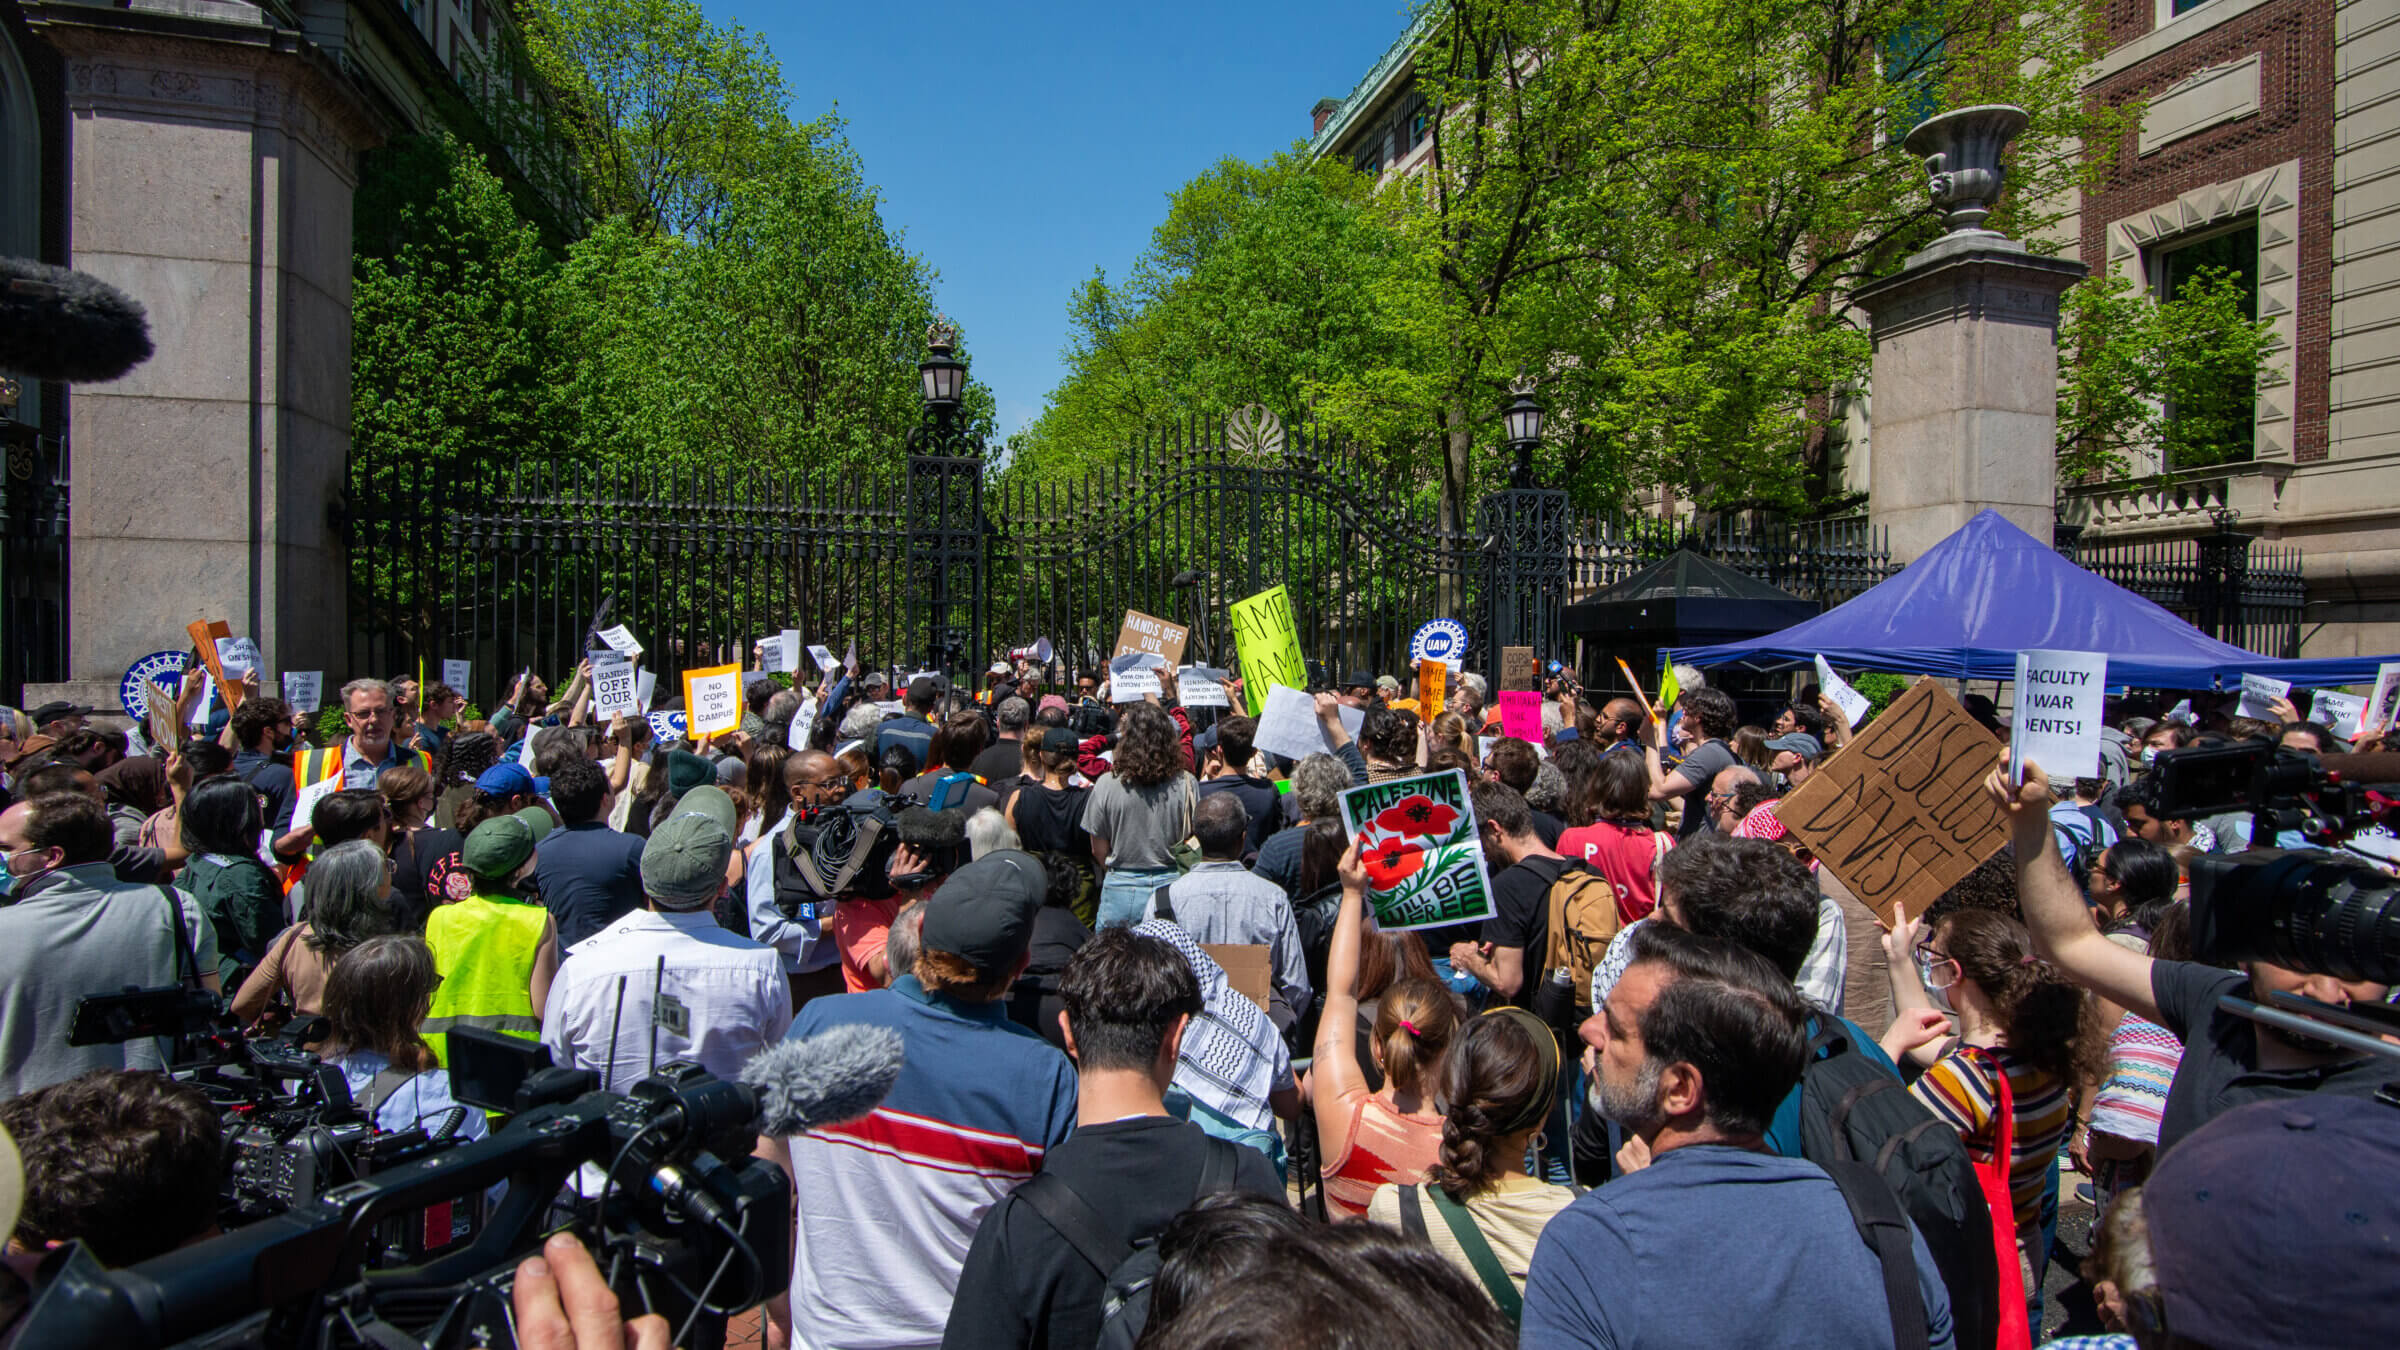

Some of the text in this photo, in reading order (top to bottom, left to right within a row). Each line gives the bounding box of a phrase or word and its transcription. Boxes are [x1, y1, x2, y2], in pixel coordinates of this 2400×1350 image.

[1126, 614, 1183, 645] HANDS OFF
[1141, 635, 1162, 653] OUR
[1426, 639, 1450, 651] UAW
[1506, 653, 1529, 665] COPS
[598, 669, 629, 680] HANDS
[1507, 665, 1528, 676] OFF
[600, 678, 630, 692] OFF
[601, 691, 631, 705] OUR
[703, 691, 728, 701] COPS
[2034, 694, 2073, 709] WAR
[698, 709, 734, 722] CAMPUS
[1349, 776, 1463, 826] PALESTINE
[1803, 773, 1954, 907] DIVEST
[1379, 861, 1479, 925] WILL BE
[1407, 887, 1485, 924] FREE
